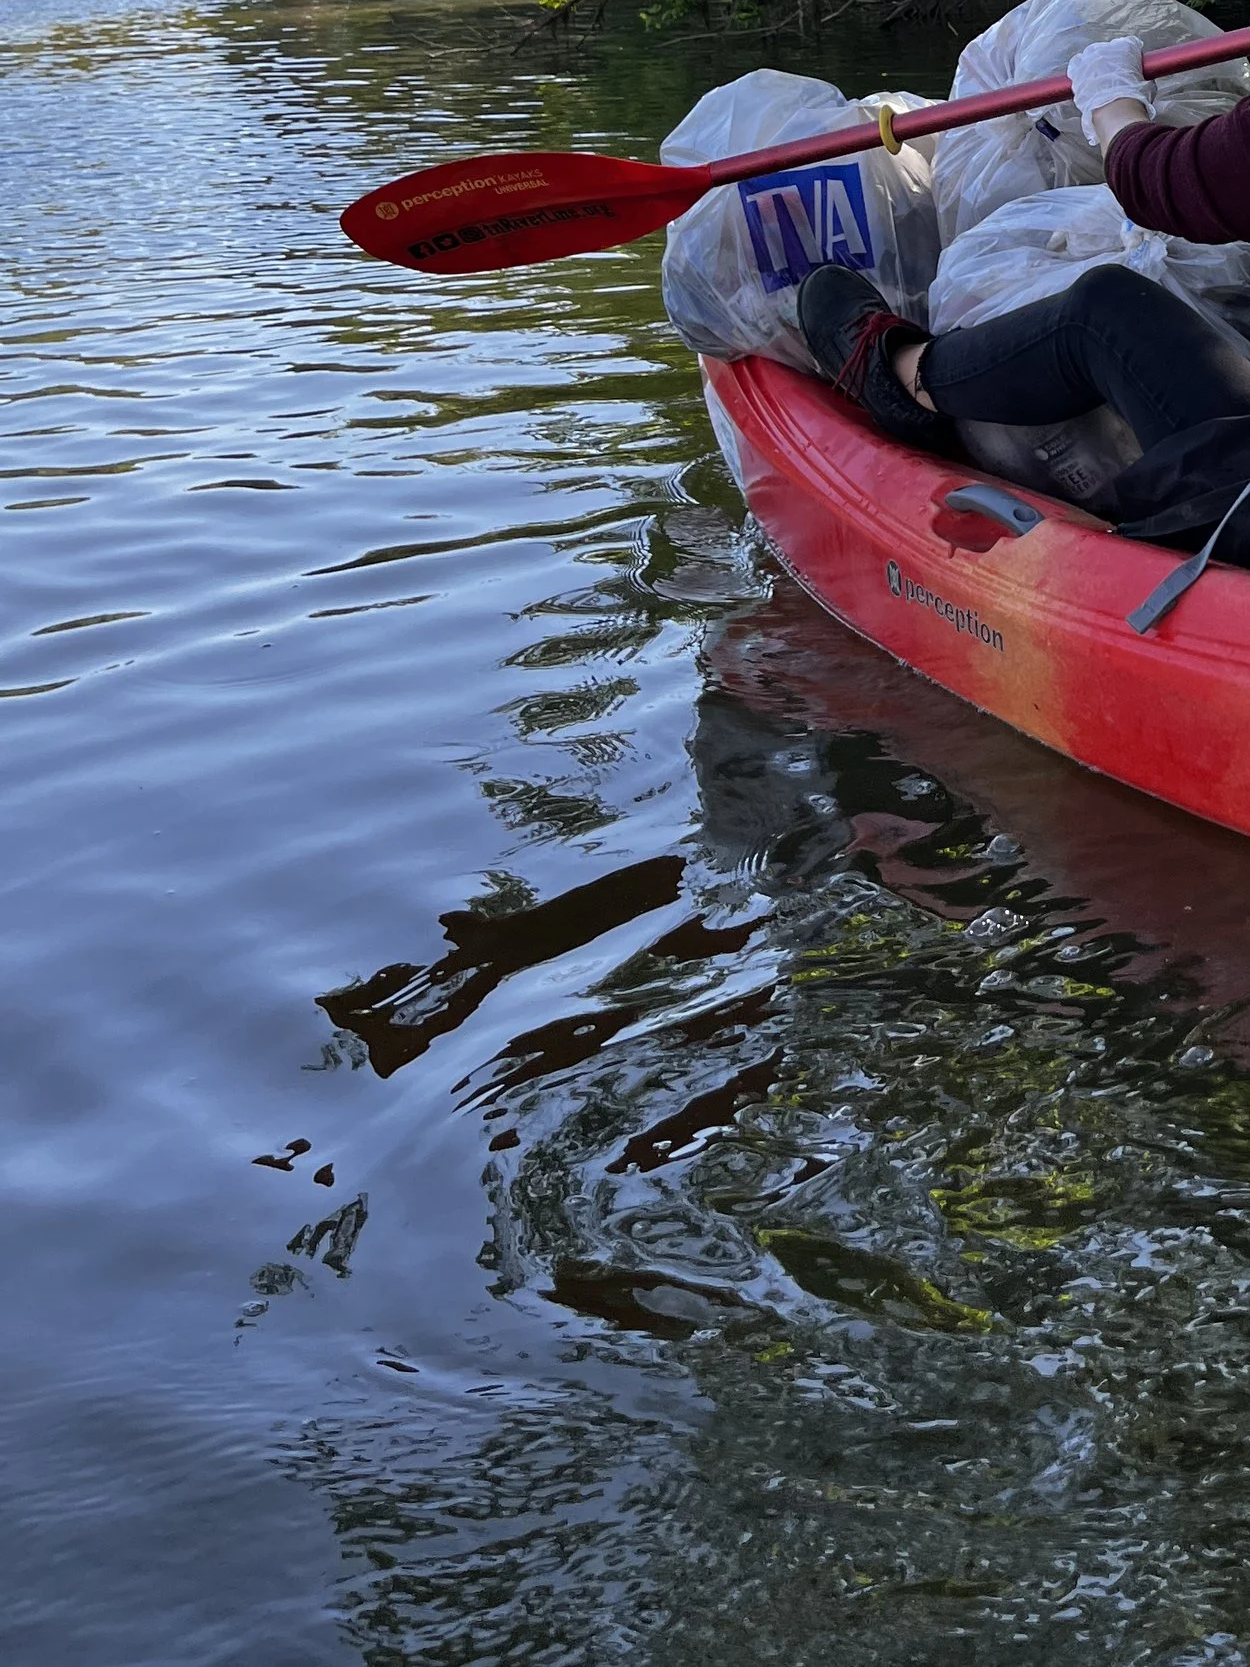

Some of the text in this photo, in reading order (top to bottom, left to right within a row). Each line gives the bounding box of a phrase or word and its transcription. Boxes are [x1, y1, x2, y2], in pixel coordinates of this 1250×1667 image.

[401, 168, 544, 212] perception KAYAKS
[494, 178, 550, 196] UNIVERSAL
[746, 179, 868, 272] TVA
[905, 578, 1005, 652] perception
